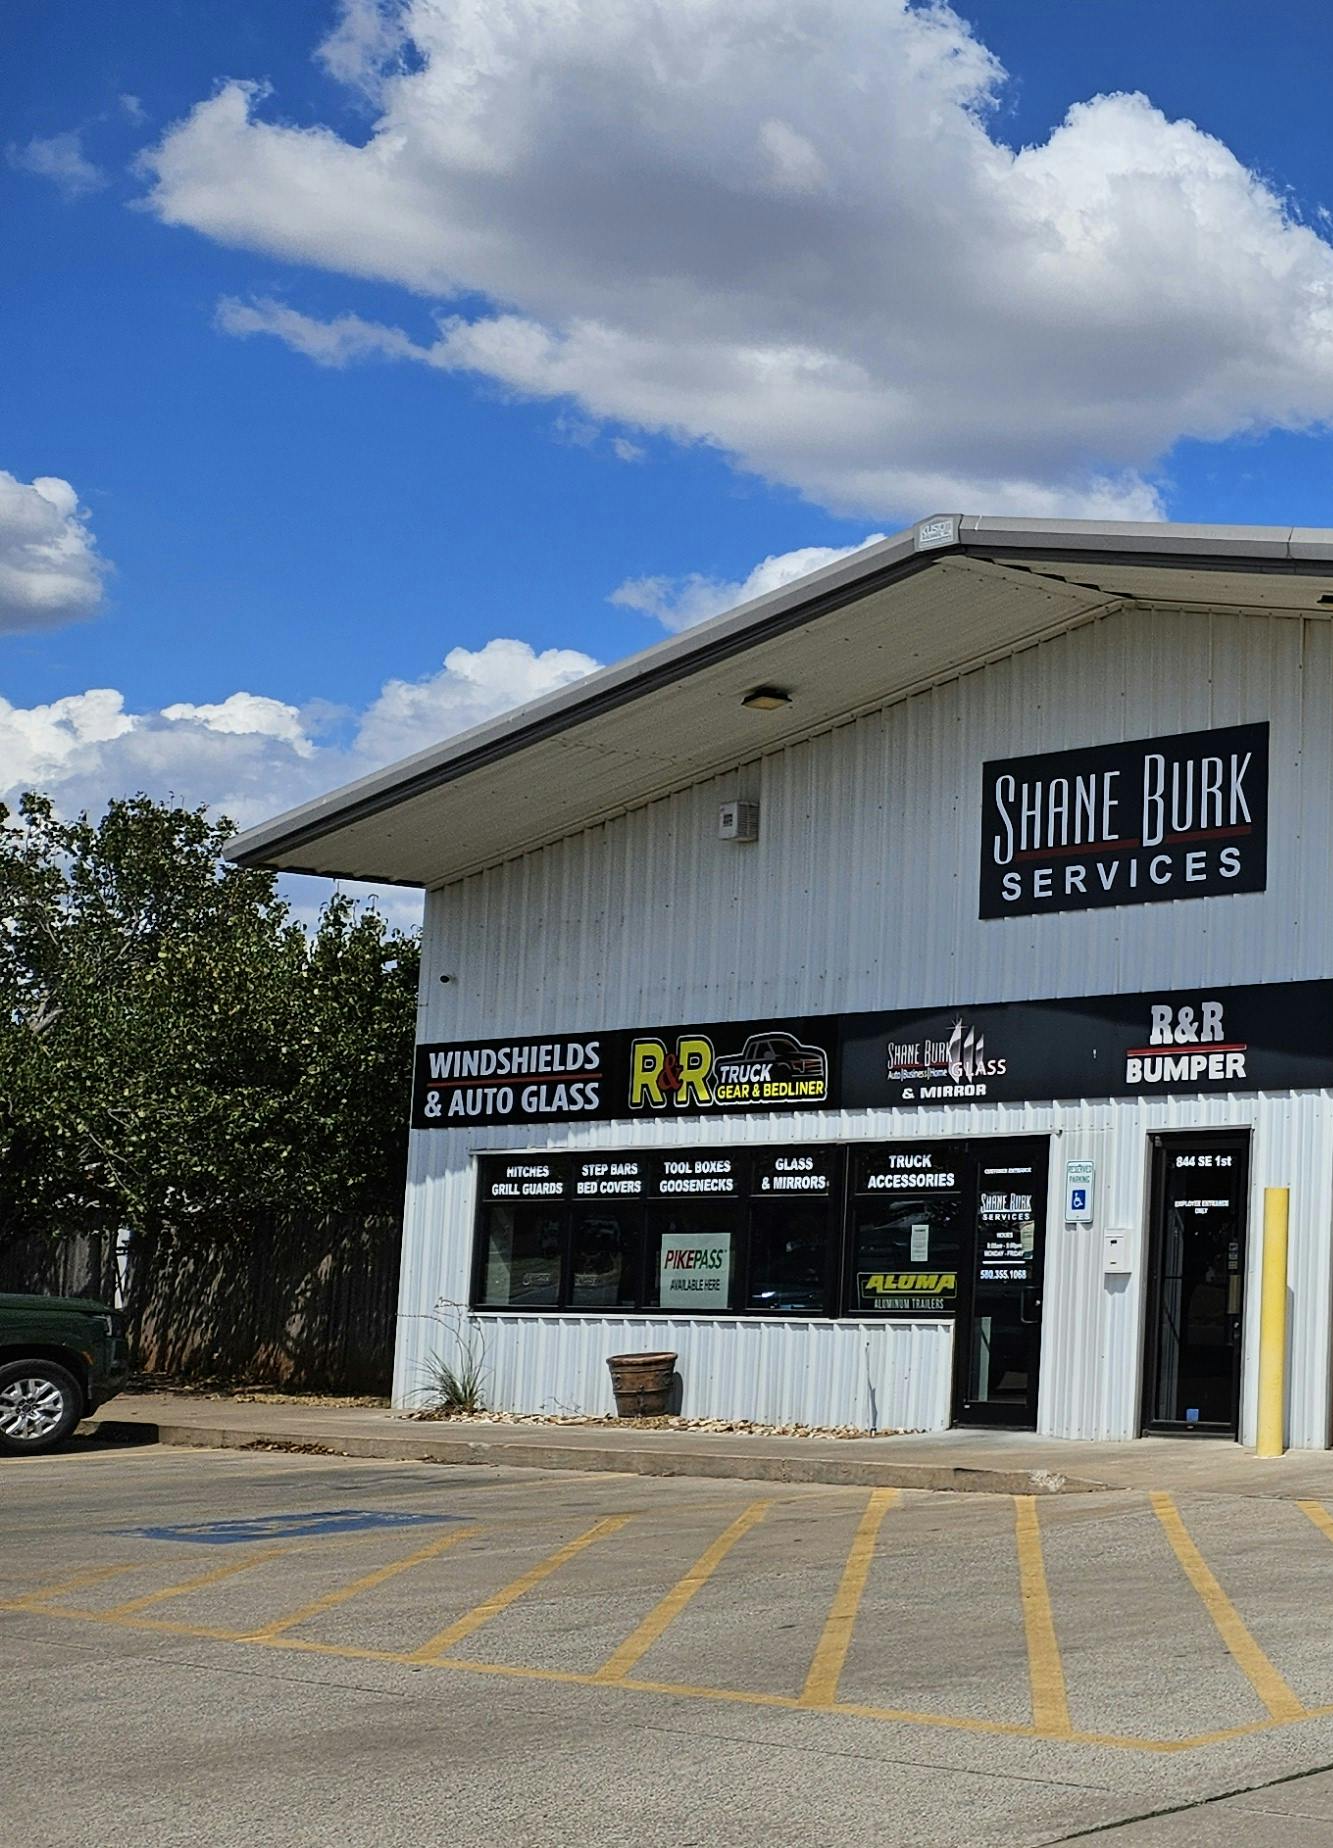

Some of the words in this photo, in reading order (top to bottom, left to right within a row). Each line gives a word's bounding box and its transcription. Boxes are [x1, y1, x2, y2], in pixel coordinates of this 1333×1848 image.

[994, 771, 1121, 865] SHANE
[1142, 752, 1253, 847] BURK
[1001, 847, 1242, 902] SERVICES
[1149, 1001, 1225, 1046] R&R
[429, 1041, 600, 1079] WINDSHIELDS
[887, 1042, 921, 1069] SHANE
[924, 1040, 953, 1067] BURK
[631, 1040, 712, 1104] R&R
[720, 1064, 774, 1083] TRUCK
[951, 1058, 1007, 1077] GLASS
[1126, 1053, 1247, 1084] BUMPER
[717, 1085, 749, 1099] GEAR
[752, 1085, 760, 1097] &
[763, 1081, 825, 1097] BEDLINER
[902, 1088, 915, 1100] &
[920, 1084, 987, 1099] MIRROR
[424, 1091, 442, 1118] &
[448, 1086, 514, 1117] AUTO
[521, 1082, 600, 1113] GLASS
[581, 1164, 608, 1176] STEP
[610, 1163, 638, 1175] BARS
[664, 1161, 692, 1174] TOOL
[695, 1160, 731, 1173] BOXES
[775, 1157, 813, 1170] GLASS
[889, 1154, 931, 1168] TRUCK
[1176, 1156, 1195, 1168] 844
[1198, 1155, 1212, 1166] SE
[1215, 1154, 1232, 1166] 1st
[506, 1165, 550, 1178] HITCHES
[491, 1184, 520, 1196] GRILL
[522, 1182, 564, 1195] GUARDS
[576, 1182, 598, 1194] BED
[600, 1181, 642, 1193] COVERS
[659, 1178, 733, 1192] GOOSENECKS
[761, 1177, 770, 1190] &
[773, 1176, 826, 1190] MIRRORS
[867, 1173, 955, 1189] ACCESSORIES
[980, 1193, 1007, 1213] SHANE
[982, 1213, 1030, 1221] SERVICES
[664, 1249, 724, 1269] PIKEPASS
[670, 1279, 703, 1291] AVAILABLE
[865, 1275, 956, 1294] ALUMA
